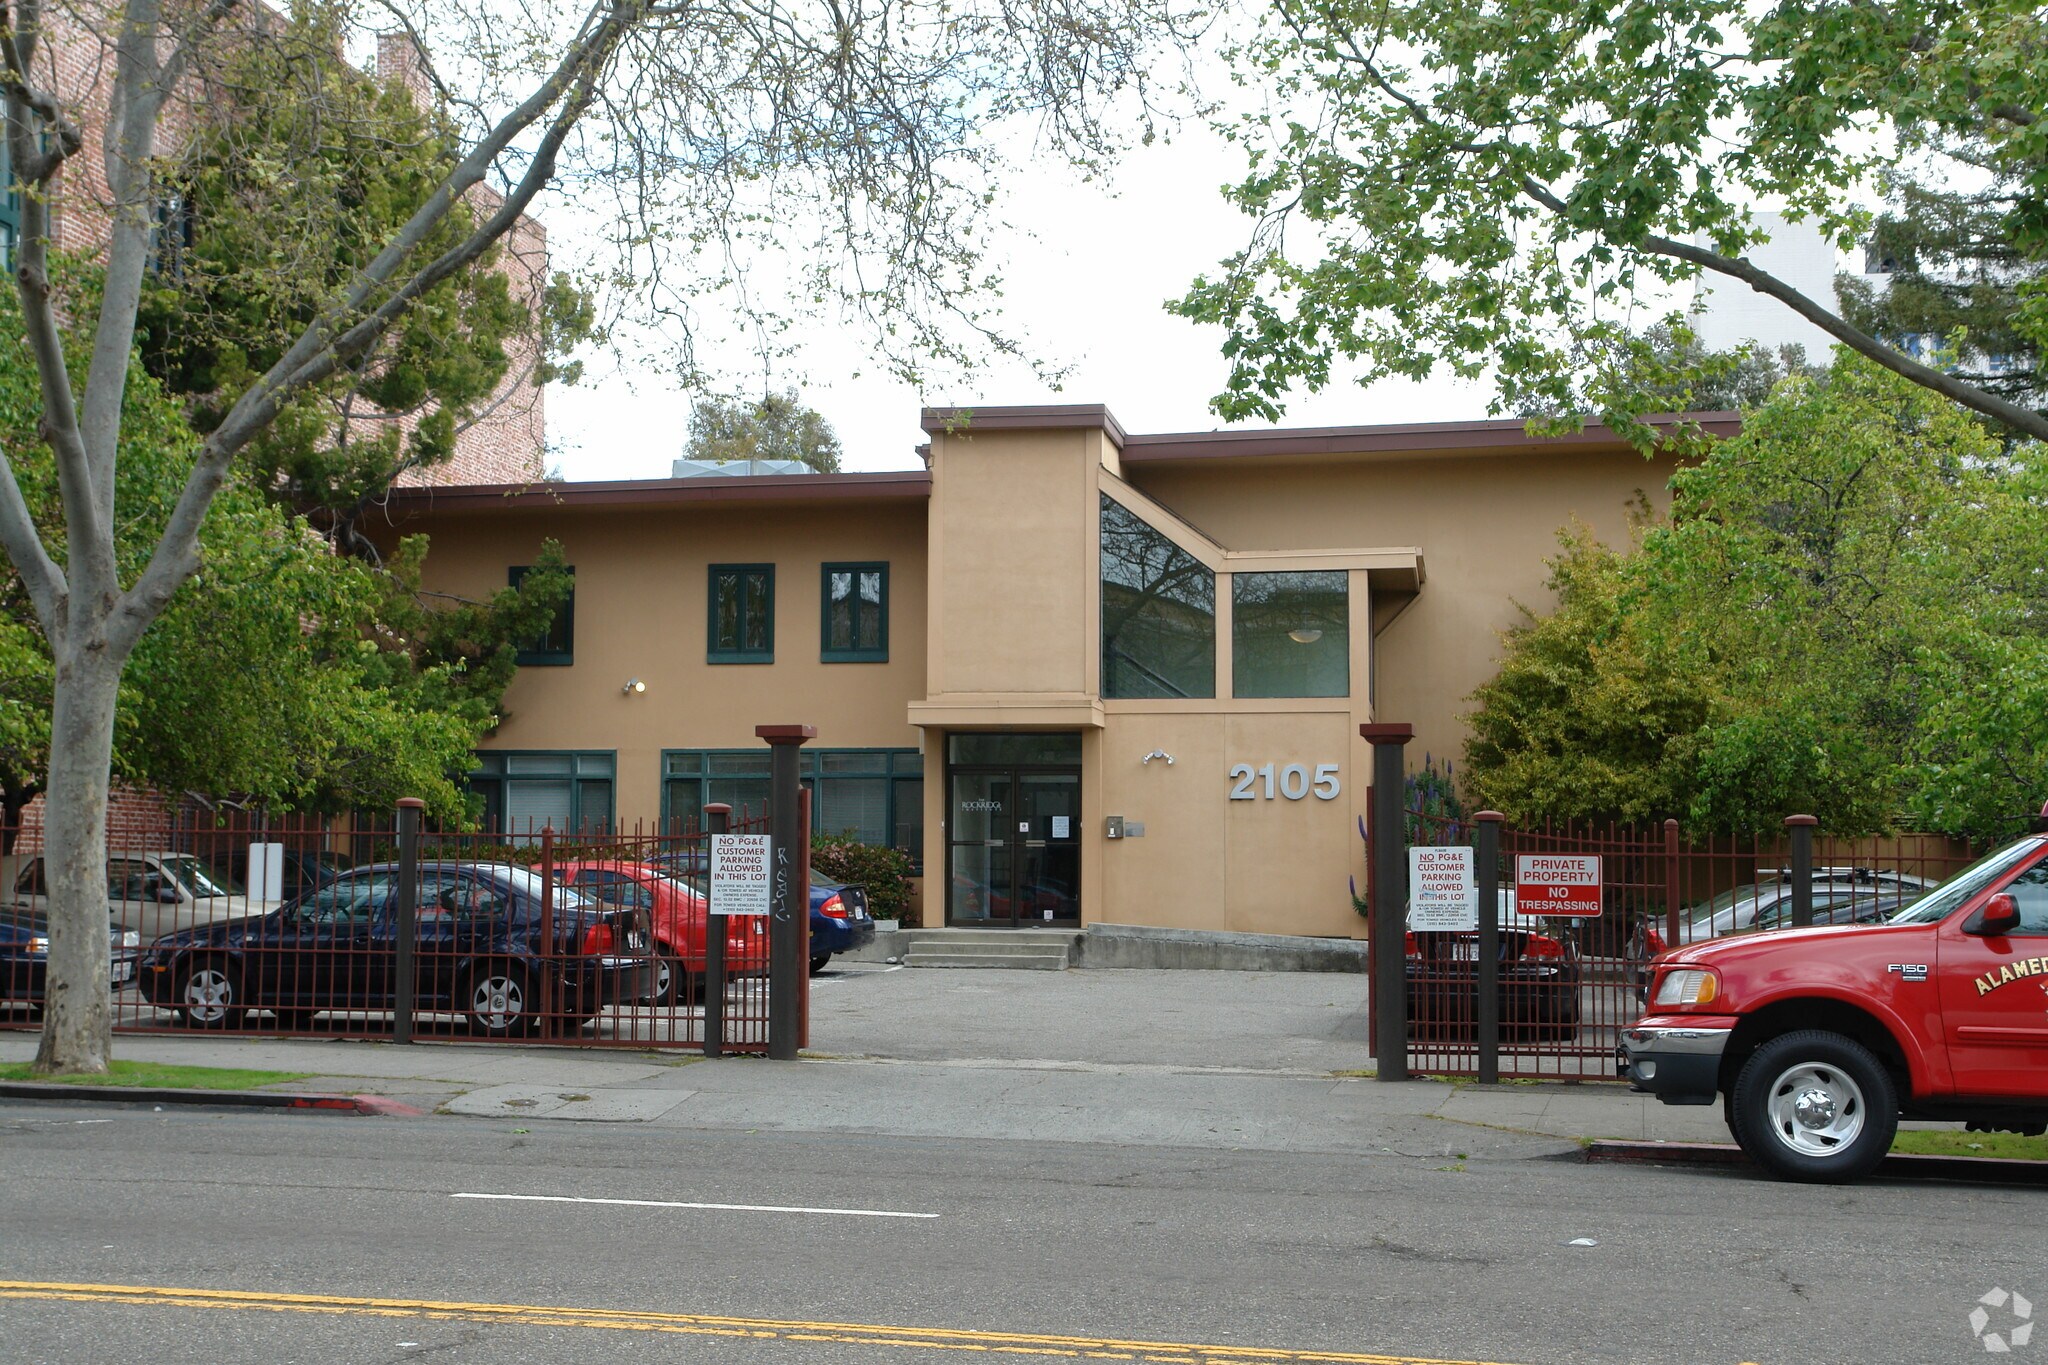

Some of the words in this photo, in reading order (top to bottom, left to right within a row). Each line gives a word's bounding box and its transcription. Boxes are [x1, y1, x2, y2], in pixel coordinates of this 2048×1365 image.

[1229, 762, 1341, 801] 2105
[719, 838, 735, 846] NO
[738, 838, 764, 846] PG&E
[716, 848, 766, 856] CUSTOMER
[720, 856, 762, 864] PARKING
[1532, 860, 1585, 870] PRIVATE
[1524, 872, 1594, 881] PROPERTY
[1548, 887, 1569, 898] NO
[1519, 900, 1598, 910] TRESPASSING
[1888, 964, 1928, 973] F-150
